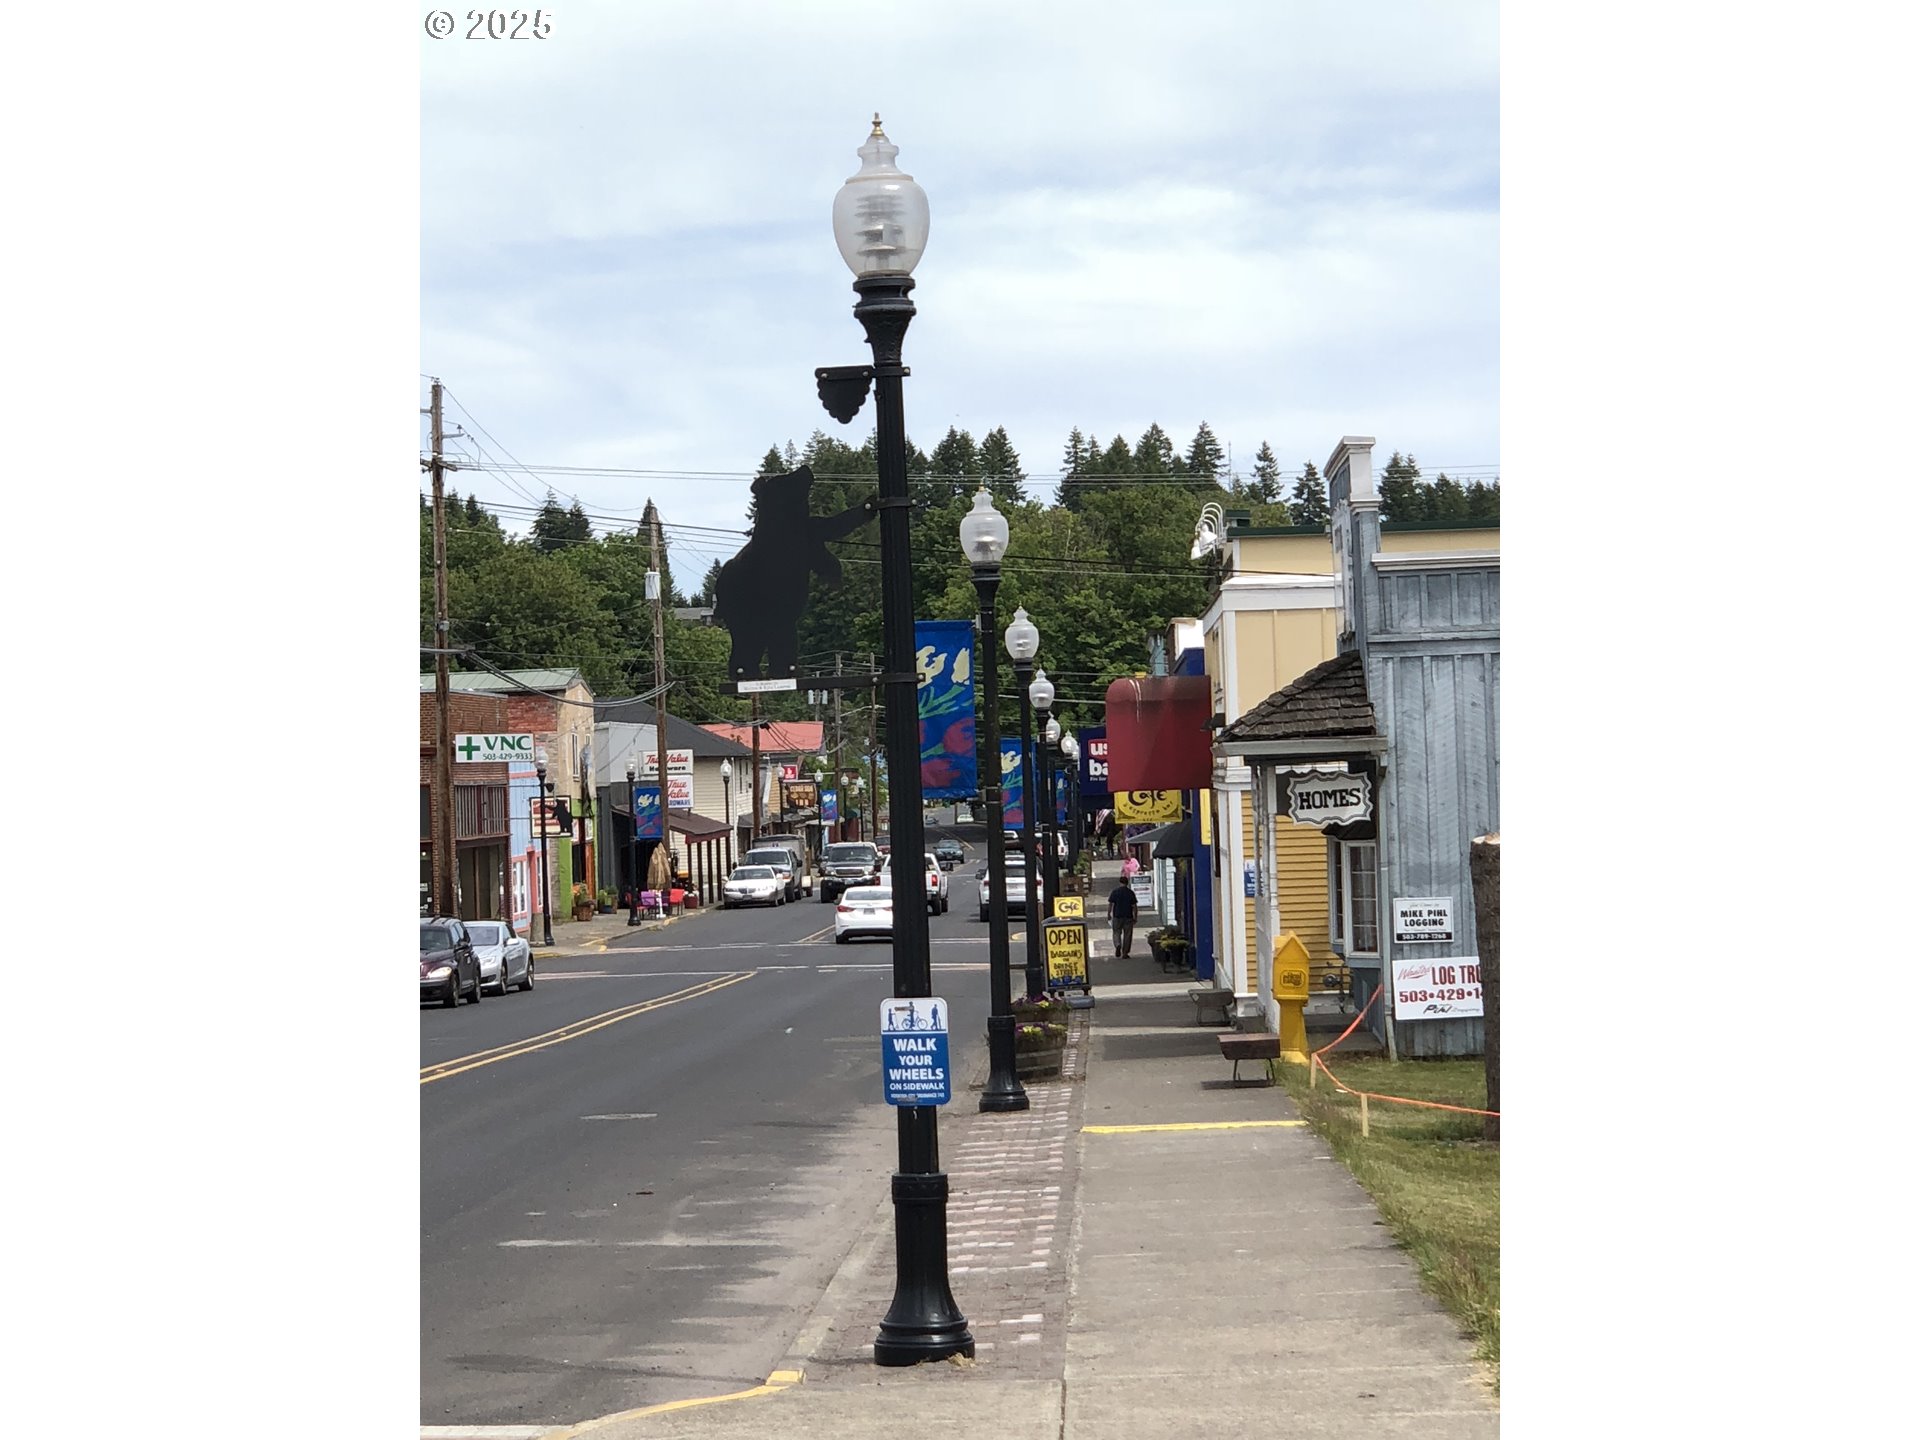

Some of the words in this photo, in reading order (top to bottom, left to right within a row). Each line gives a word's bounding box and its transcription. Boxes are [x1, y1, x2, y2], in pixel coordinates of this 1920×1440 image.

[483, 735, 532, 751] VNC
[482, 753, 533, 761] 503-429-9333
[1088, 759, 1109, 776] ba
[1298, 787, 1362, 810] HOMES
[1400, 909, 1424, 918] MIKE
[1427, 909, 1448, 917] PIHL
[1404, 918, 1445, 927] LOGGING
[1048, 929, 1082, 945] OPEN
[1432, 966, 1456, 985] LOG
[1459, 965, 1482, 984] TRU
[893, 1038, 937, 1051] WALK
[899, 1055, 932, 1066] YOUR
[889, 1068, 944, 1080] WHEELS
[903, 1082, 944, 1090] SIDEWALK
